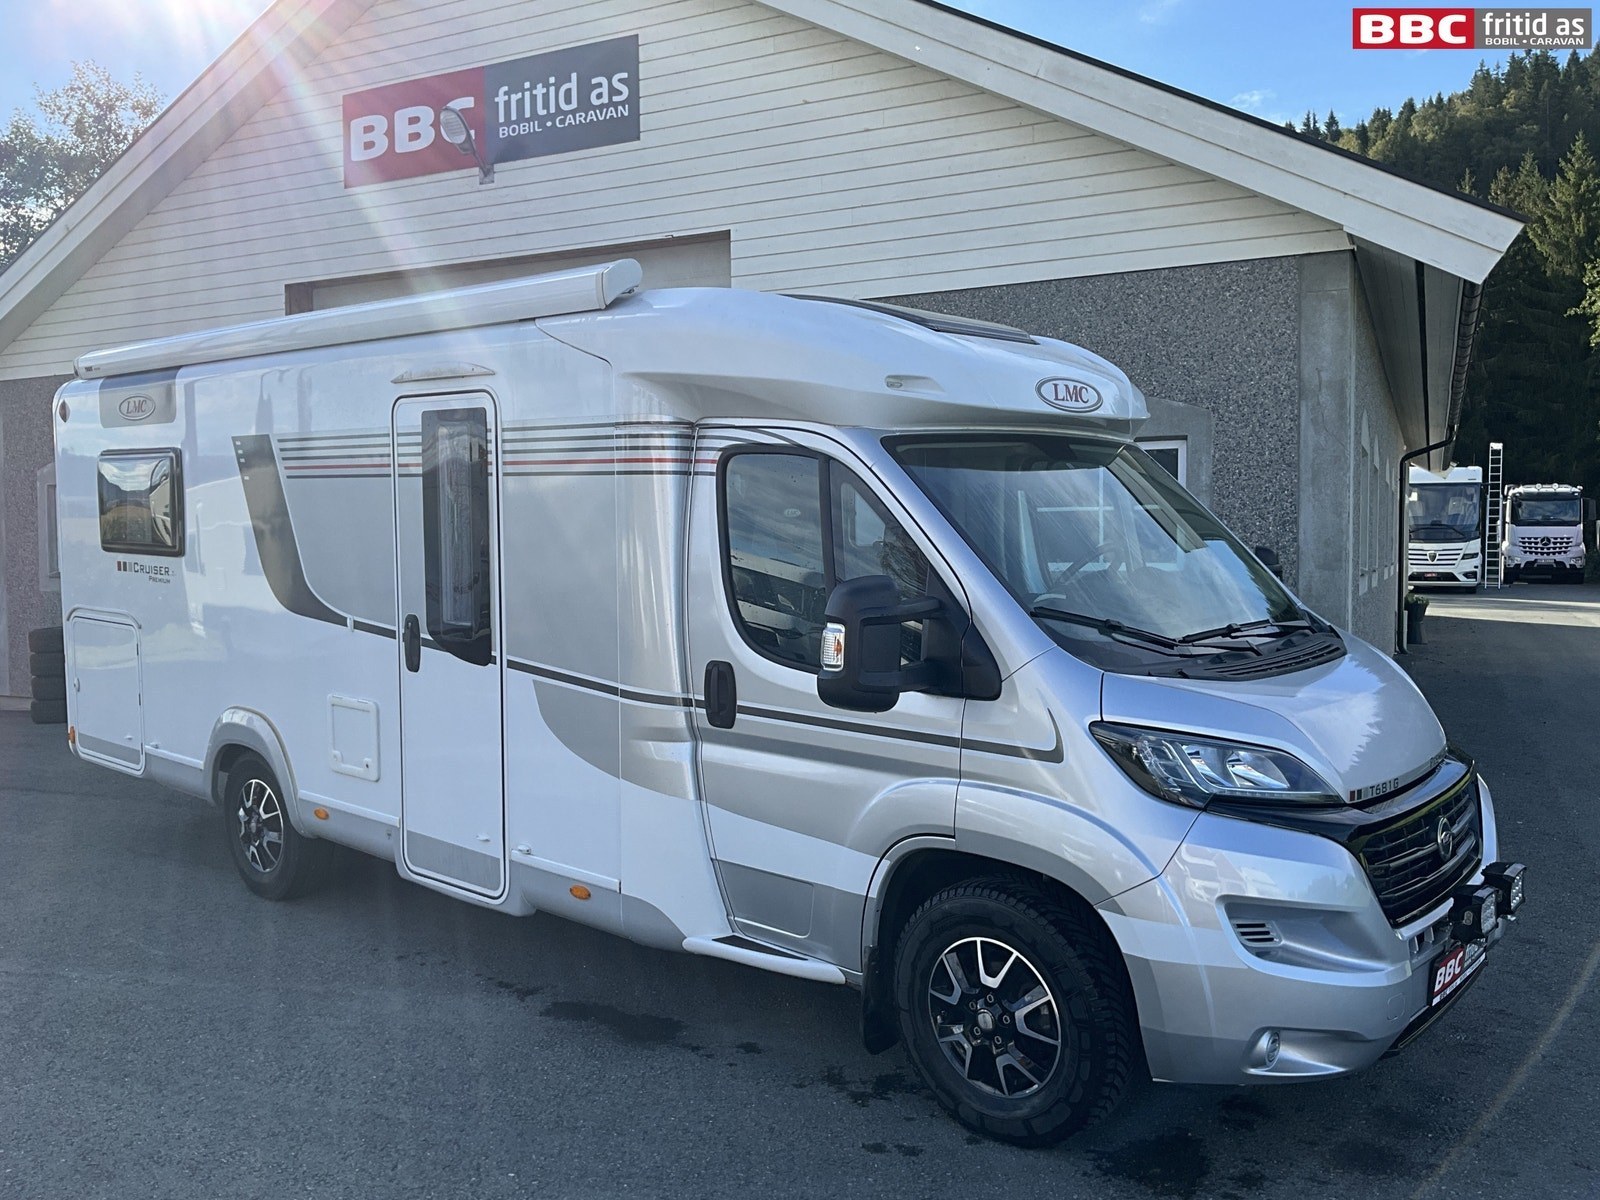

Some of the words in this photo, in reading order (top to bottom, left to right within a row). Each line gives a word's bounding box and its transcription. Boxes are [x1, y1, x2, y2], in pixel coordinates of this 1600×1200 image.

[494, 72, 578, 123] fritid
[590, 72, 629, 106] as
[499, 122, 542, 138] BOBIL
[555, 104, 629, 128] CARAVAN
[126, 400, 147, 414] LMC
[1052, 383, 1089, 404] LMC
[1434, 951, 1464, 992] BBC
